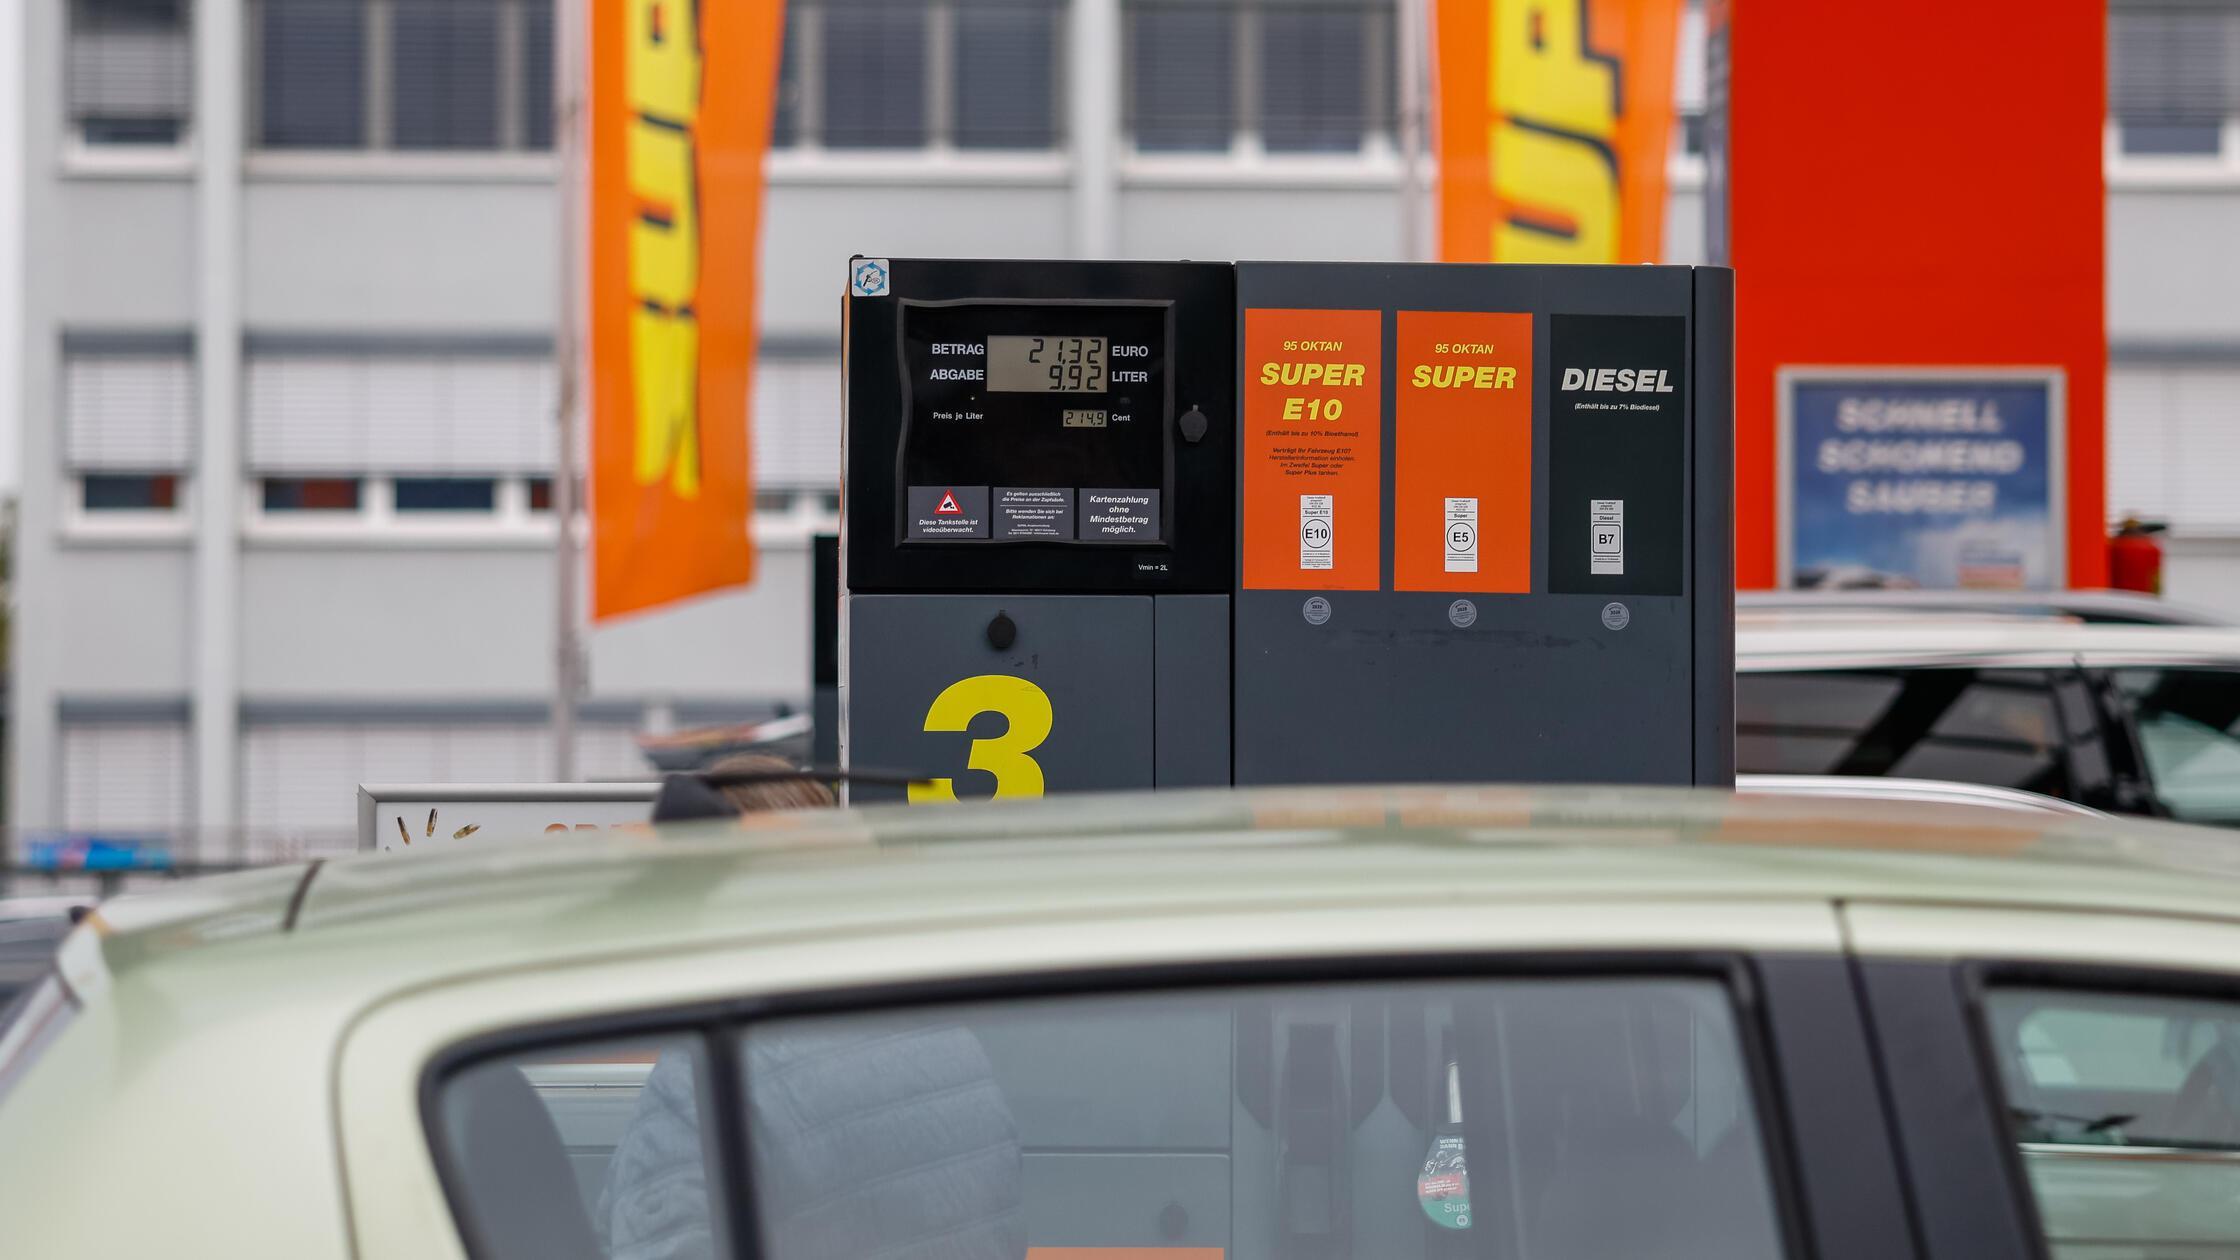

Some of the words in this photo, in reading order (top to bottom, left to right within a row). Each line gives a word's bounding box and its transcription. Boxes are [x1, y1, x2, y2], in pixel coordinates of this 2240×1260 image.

[931, 343, 985, 356] BETRAG
[1028, 338, 1102, 365] 21,32
[1112, 346, 1149, 358] EURO
[1283, 341, 1298, 351] 95
[1300, 341, 1343, 352] OKTAN
[1435, 344, 1449, 354] 95
[1452, 344, 1494, 354] OKTAN
[930, 369, 984, 381] ABGABE
[1049, 364, 1102, 391] 9,92
[1112, 371, 1149, 383] LITER
[1260, 362, 1366, 386] SUPER
[1411, 365, 1517, 390] SUPER
[1561, 368, 1674, 393] DIESEL
[1282, 398, 1343, 421] E10
[1574, 403, 1599, 411] (Enthält
[933, 412, 953, 420] Preis
[955, 412, 963, 422] je
[966, 412, 984, 420] Liter
[1065, 412, 1104, 426] 214,9
[1112, 414, 1131, 422] Cent
[1089, 496, 1149, 505] Kartenzahlung
[1089, 515, 1149, 525] Mindestbetrag
[1102, 526, 1136, 534] möglich.
[1305, 528, 1328, 539] E10
[1453, 532, 1469, 542] E5
[1598, 534, 1615, 545] B7
[907, 674, 1053, 805] 3
